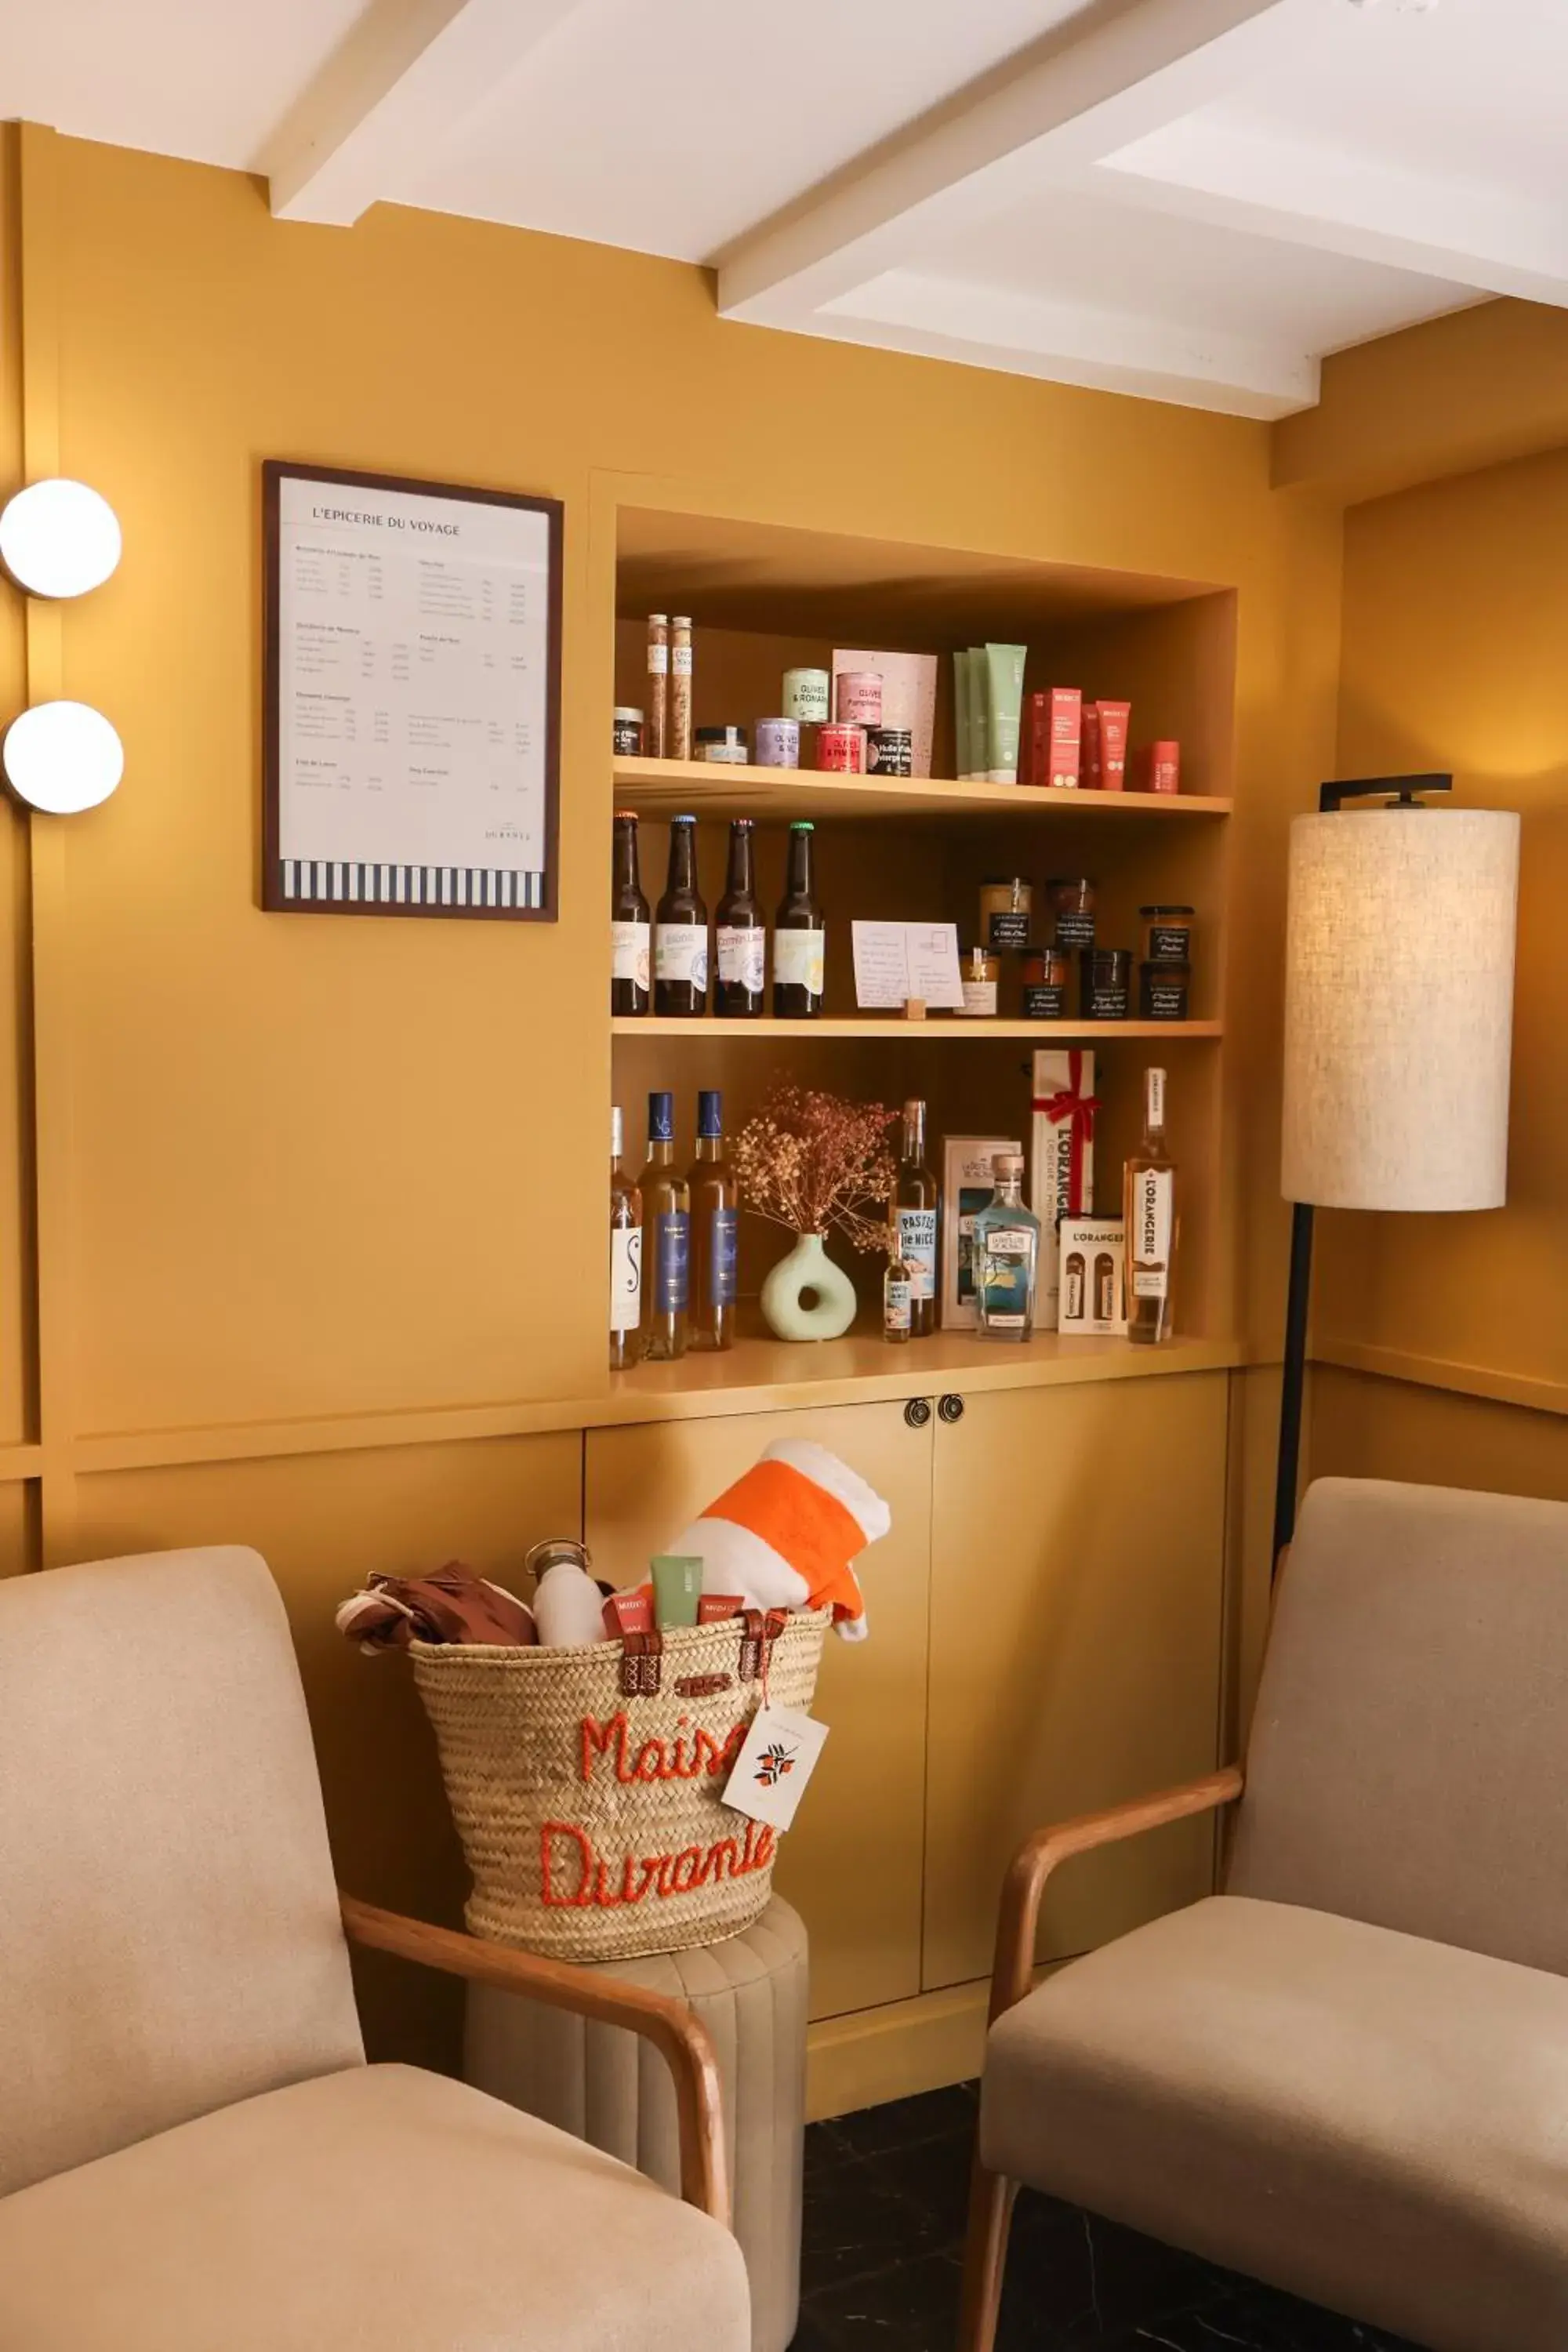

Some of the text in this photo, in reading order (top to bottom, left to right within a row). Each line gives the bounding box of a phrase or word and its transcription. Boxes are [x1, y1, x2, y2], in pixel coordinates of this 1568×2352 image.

[313, 506, 461, 536] L'EPICERIE DU VOYAGE
[1145, 1180, 1156, 1255] L'ORANGERIE
